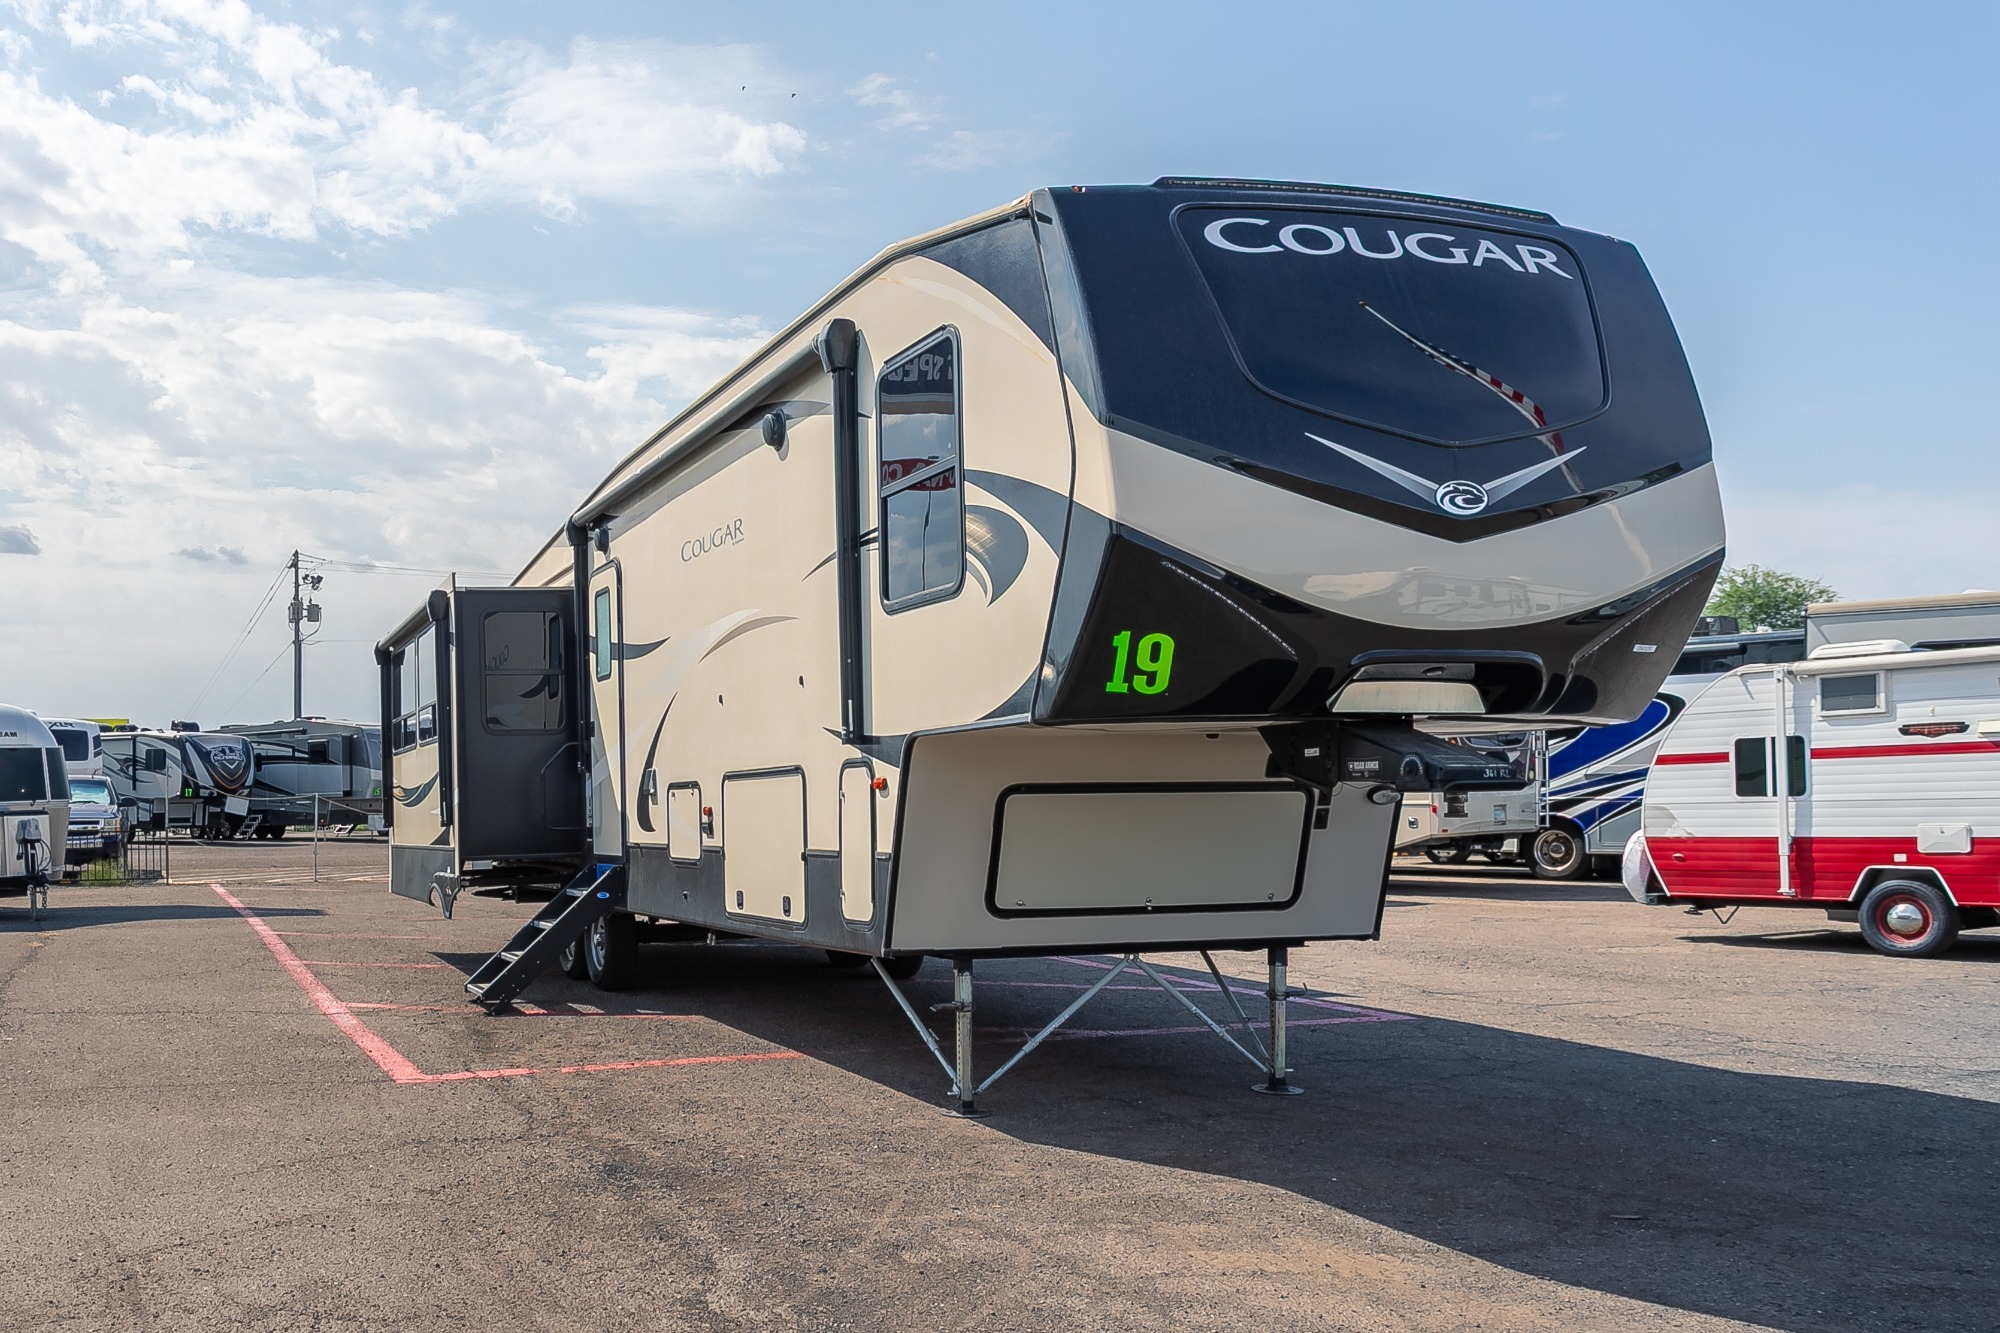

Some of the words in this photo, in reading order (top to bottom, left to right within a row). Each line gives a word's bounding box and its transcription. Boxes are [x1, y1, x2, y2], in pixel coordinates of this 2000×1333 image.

[1203, 217, 1574, 280] COUGAR
[681, 518, 745, 562] COUGAR
[1106, 631, 1175, 694] 19
[184, 788, 193, 797] 17
[1483, 768, 1498, 778] 361
[1500, 769, 1511, 778] RL
